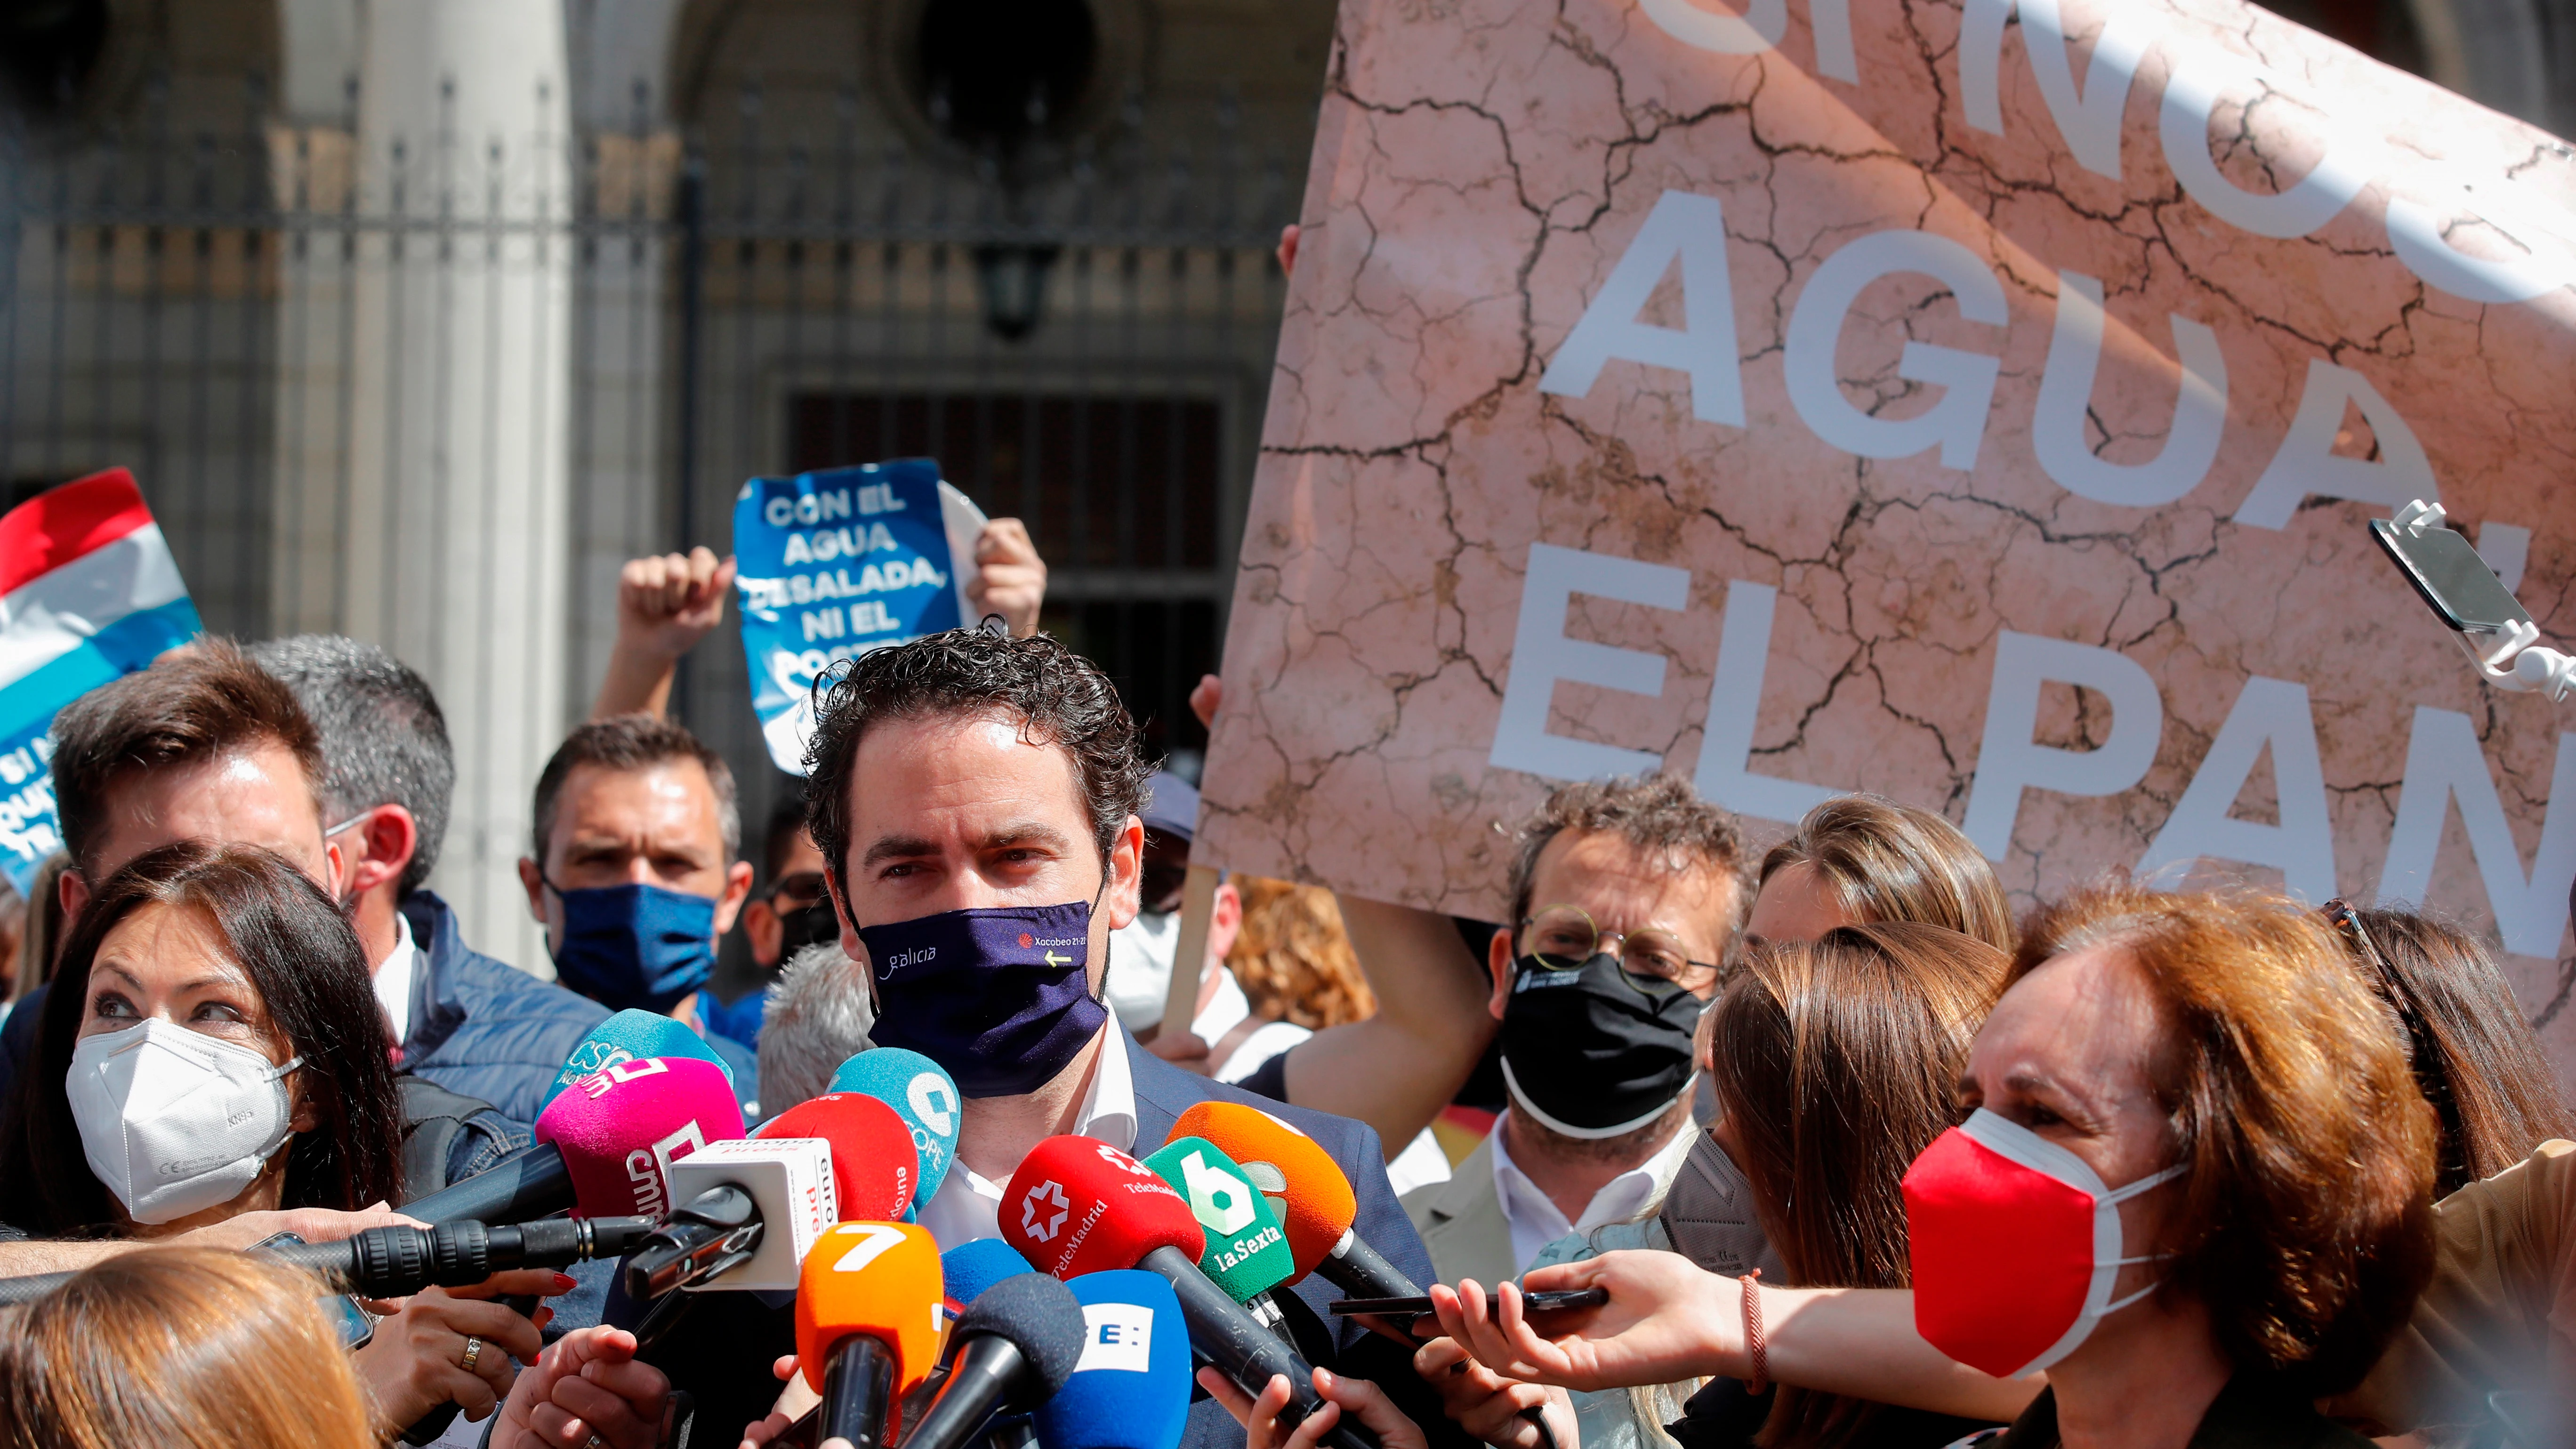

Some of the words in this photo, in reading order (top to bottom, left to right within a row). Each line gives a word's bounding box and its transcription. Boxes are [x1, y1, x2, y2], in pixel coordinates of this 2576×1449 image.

[765, 488, 851, 527] CON
[857, 482, 907, 515] EL
[783, 522, 898, 566] AGUA
[747, 556, 947, 610] DESALADA,
[802, 607, 845, 642] NI
[850, 600, 901, 635] EL
[1489, 541, 1848, 827] EL
[1957, 630, 2576, 960] PAN
[879, 947, 936, 980] galicia
[1035, 937, 1071, 946] Xacobeo
[227, 1108, 255, 1128] KN95
[904, 1120, 944, 1172] OPE
[821, 1158, 833, 1231] euro
[889, 1166, 907, 1221] europ
[1180, 1149, 1256, 1236] 6
[833, 1224, 907, 1271] 7
[1051, 1199, 1108, 1279] TeleMadrid
